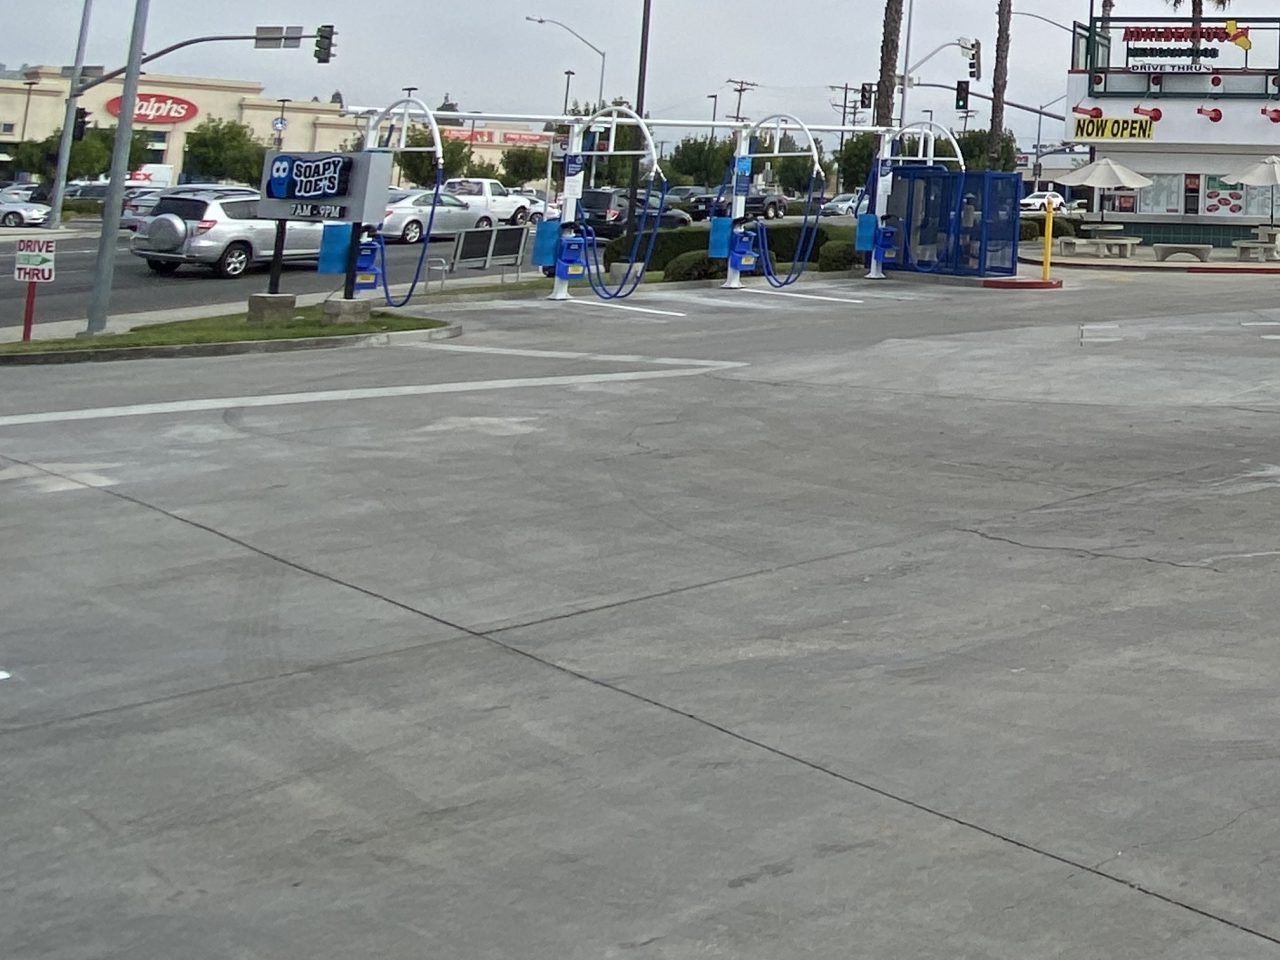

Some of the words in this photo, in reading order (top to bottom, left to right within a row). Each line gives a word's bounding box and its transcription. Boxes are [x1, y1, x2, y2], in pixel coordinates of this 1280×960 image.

[1131, 64, 1166, 72] DRIVE
[1170, 65, 1202, 73] THRU
[1075, 119, 1107, 137] NOW
[1111, 119, 1153, 138] OPEN!
[294, 159, 342, 179] SOAPY
[297, 176, 337, 194] JOE'S
[291, 204, 312, 216] 7AM
[319, 205, 341, 218] 9PM
[18, 239, 54, 253] DRIVE
[16, 267, 52, 281] THRU
